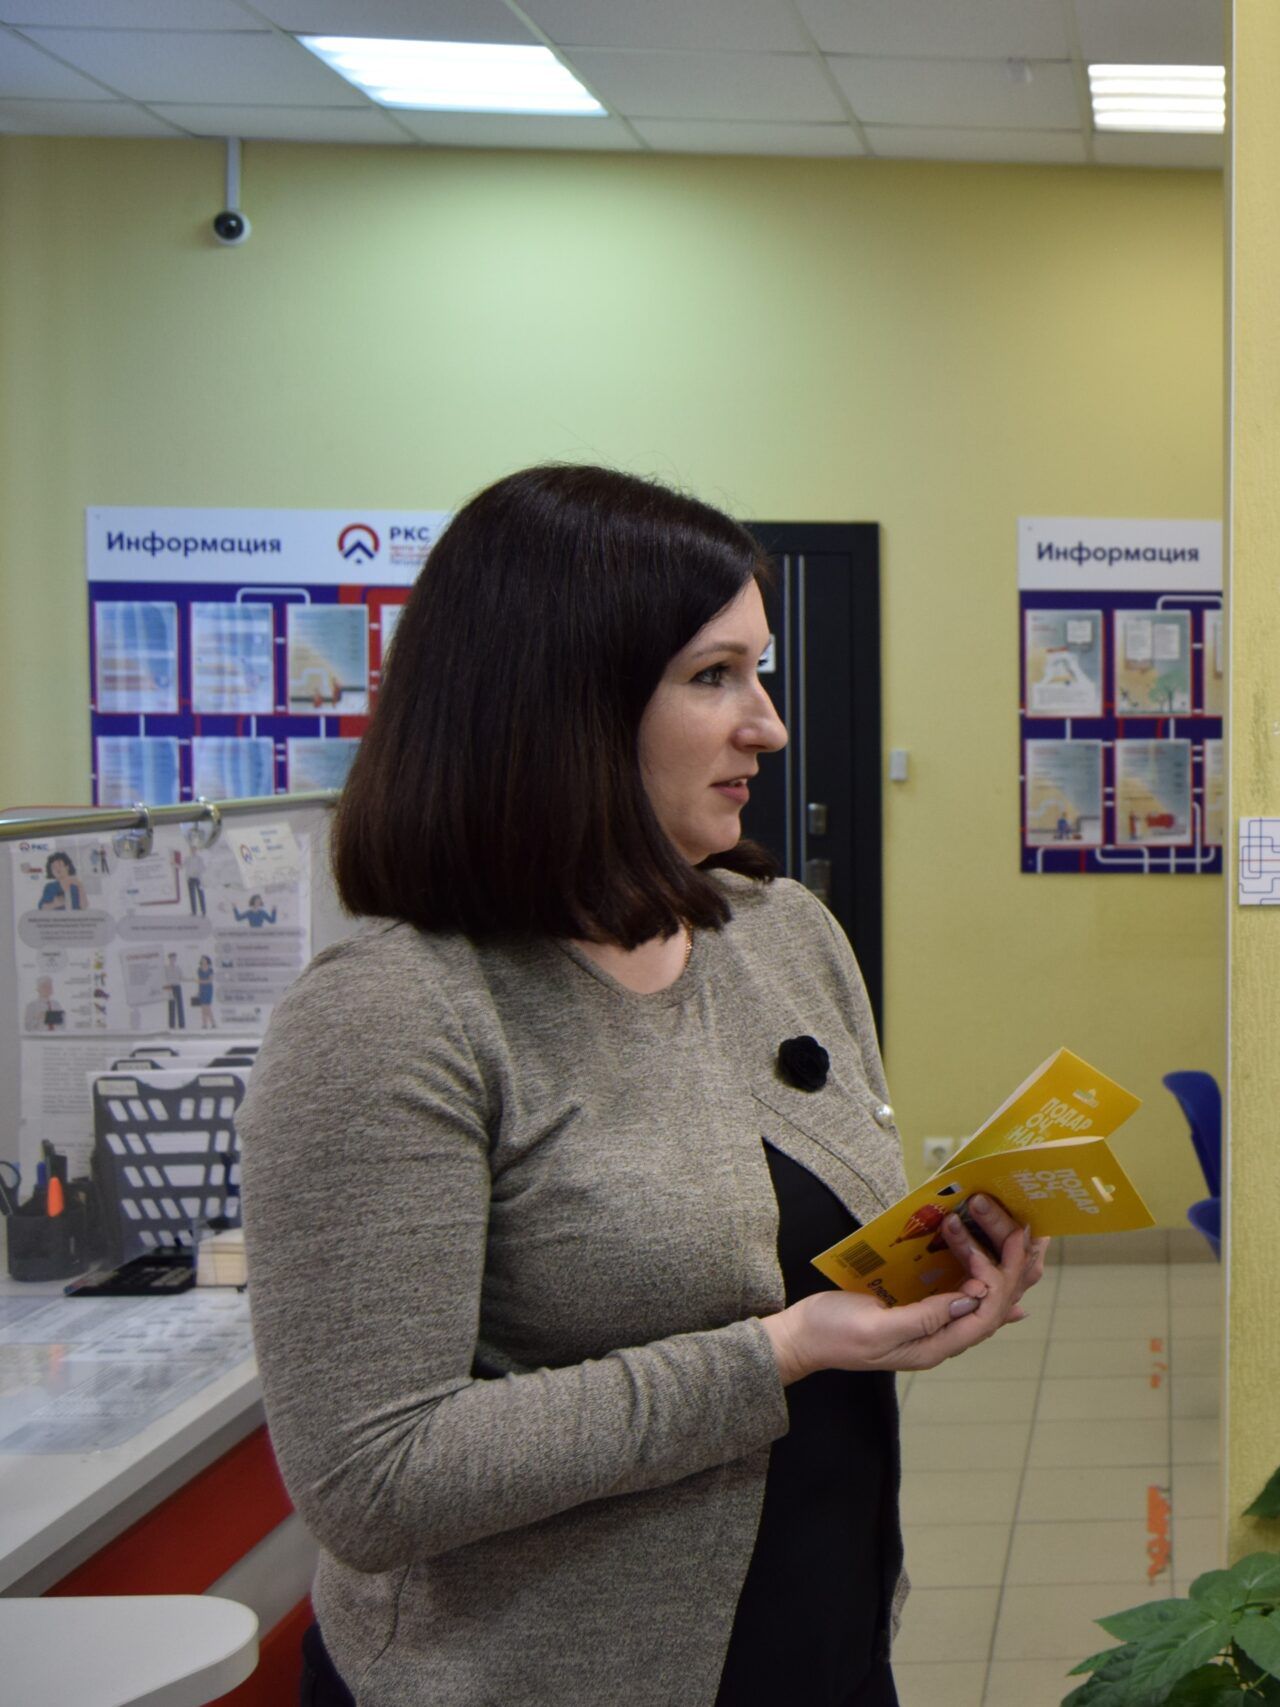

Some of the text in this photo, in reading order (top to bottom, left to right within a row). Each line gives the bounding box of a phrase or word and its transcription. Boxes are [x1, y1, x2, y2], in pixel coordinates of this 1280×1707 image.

[106, 530, 282, 557] Информация
[389, 526, 430, 541] РКС
[1036, 541, 1200, 566] Информация
[1025, 1112, 1054, 1133] ОЧ
[1039, 1097, 1093, 1132] ПОДАР
[1035, 1169, 1064, 1191] ОЧ
[1054, 1168, 1100, 1214] ПОДАР
